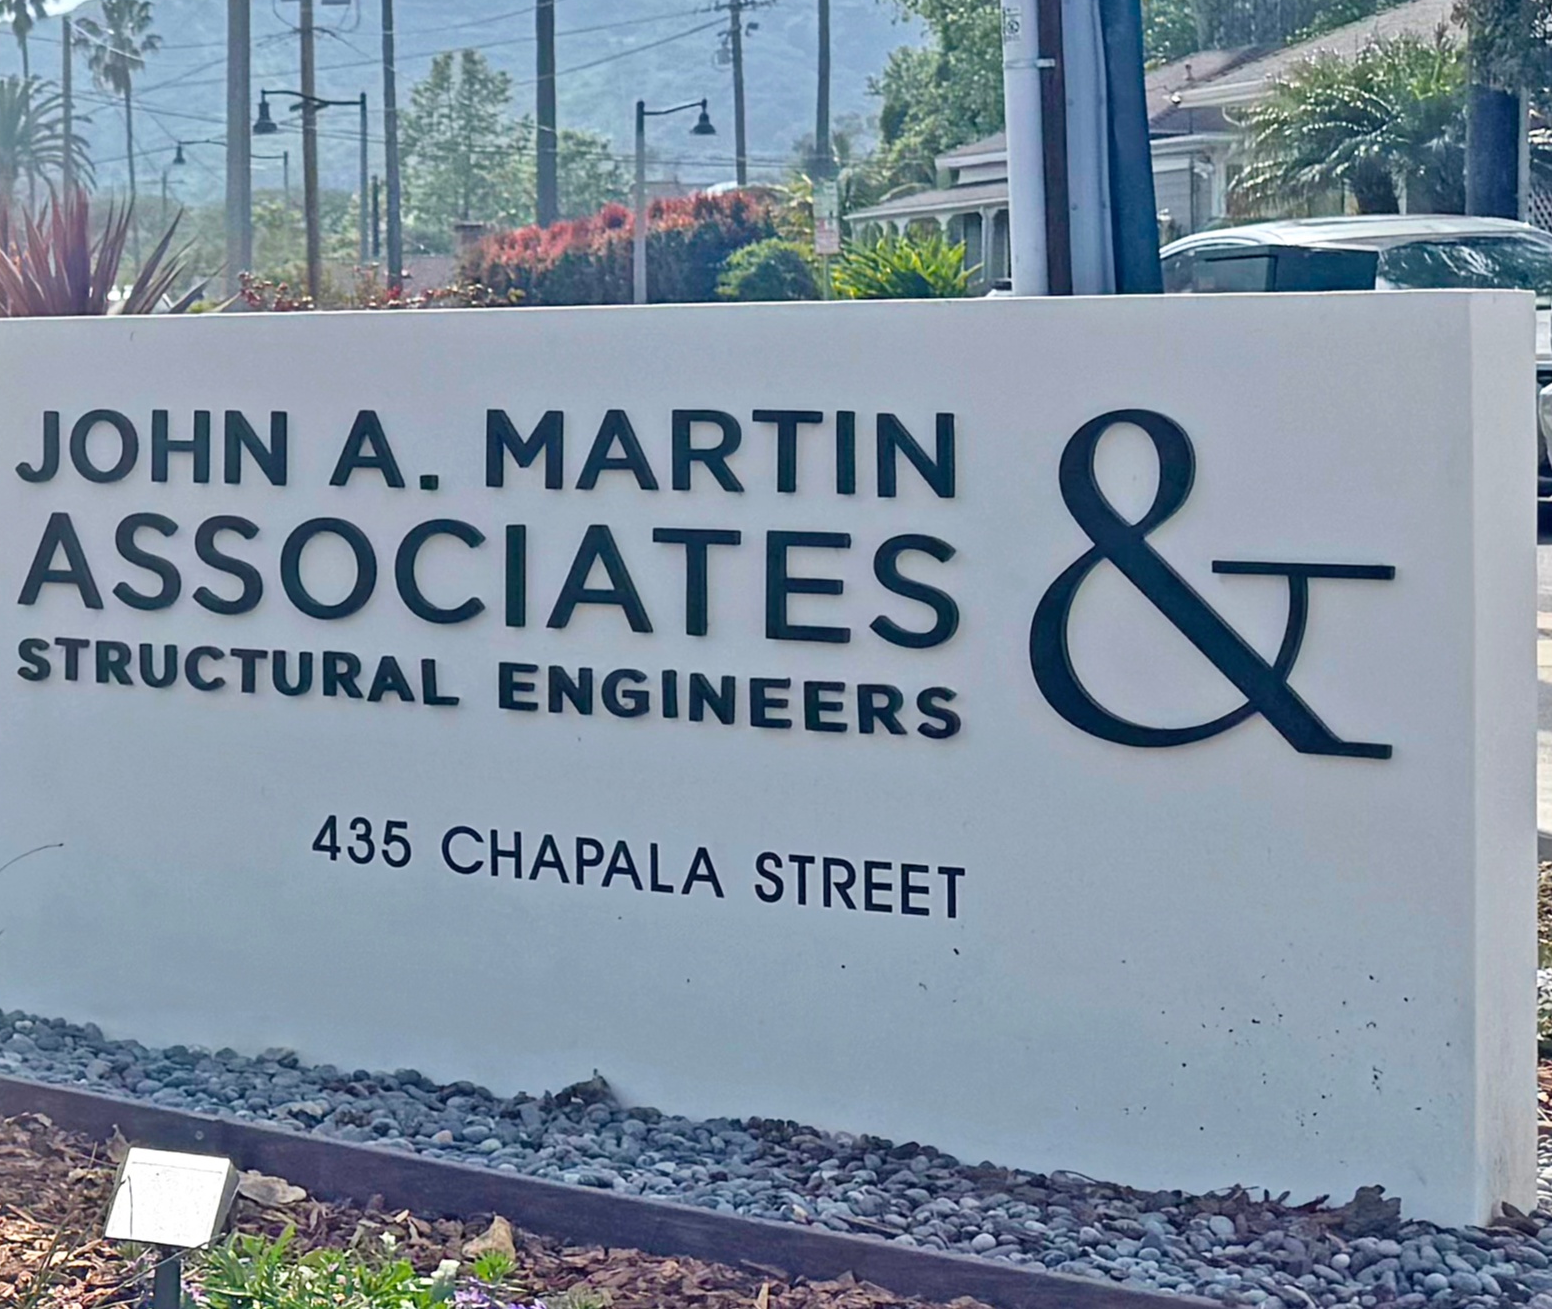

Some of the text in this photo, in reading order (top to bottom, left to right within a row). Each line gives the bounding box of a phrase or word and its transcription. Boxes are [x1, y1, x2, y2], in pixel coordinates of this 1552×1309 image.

[16, 407, 957, 499] JOHN A. MARTIN
[16, 511, 960, 650] ASSOCIATES
[1029, 408, 1398, 761] &
[16, 636, 963, 741] STRUCTURAL ENGINEERS
[311, 813, 967, 920] 435 CHAPALA STREET
